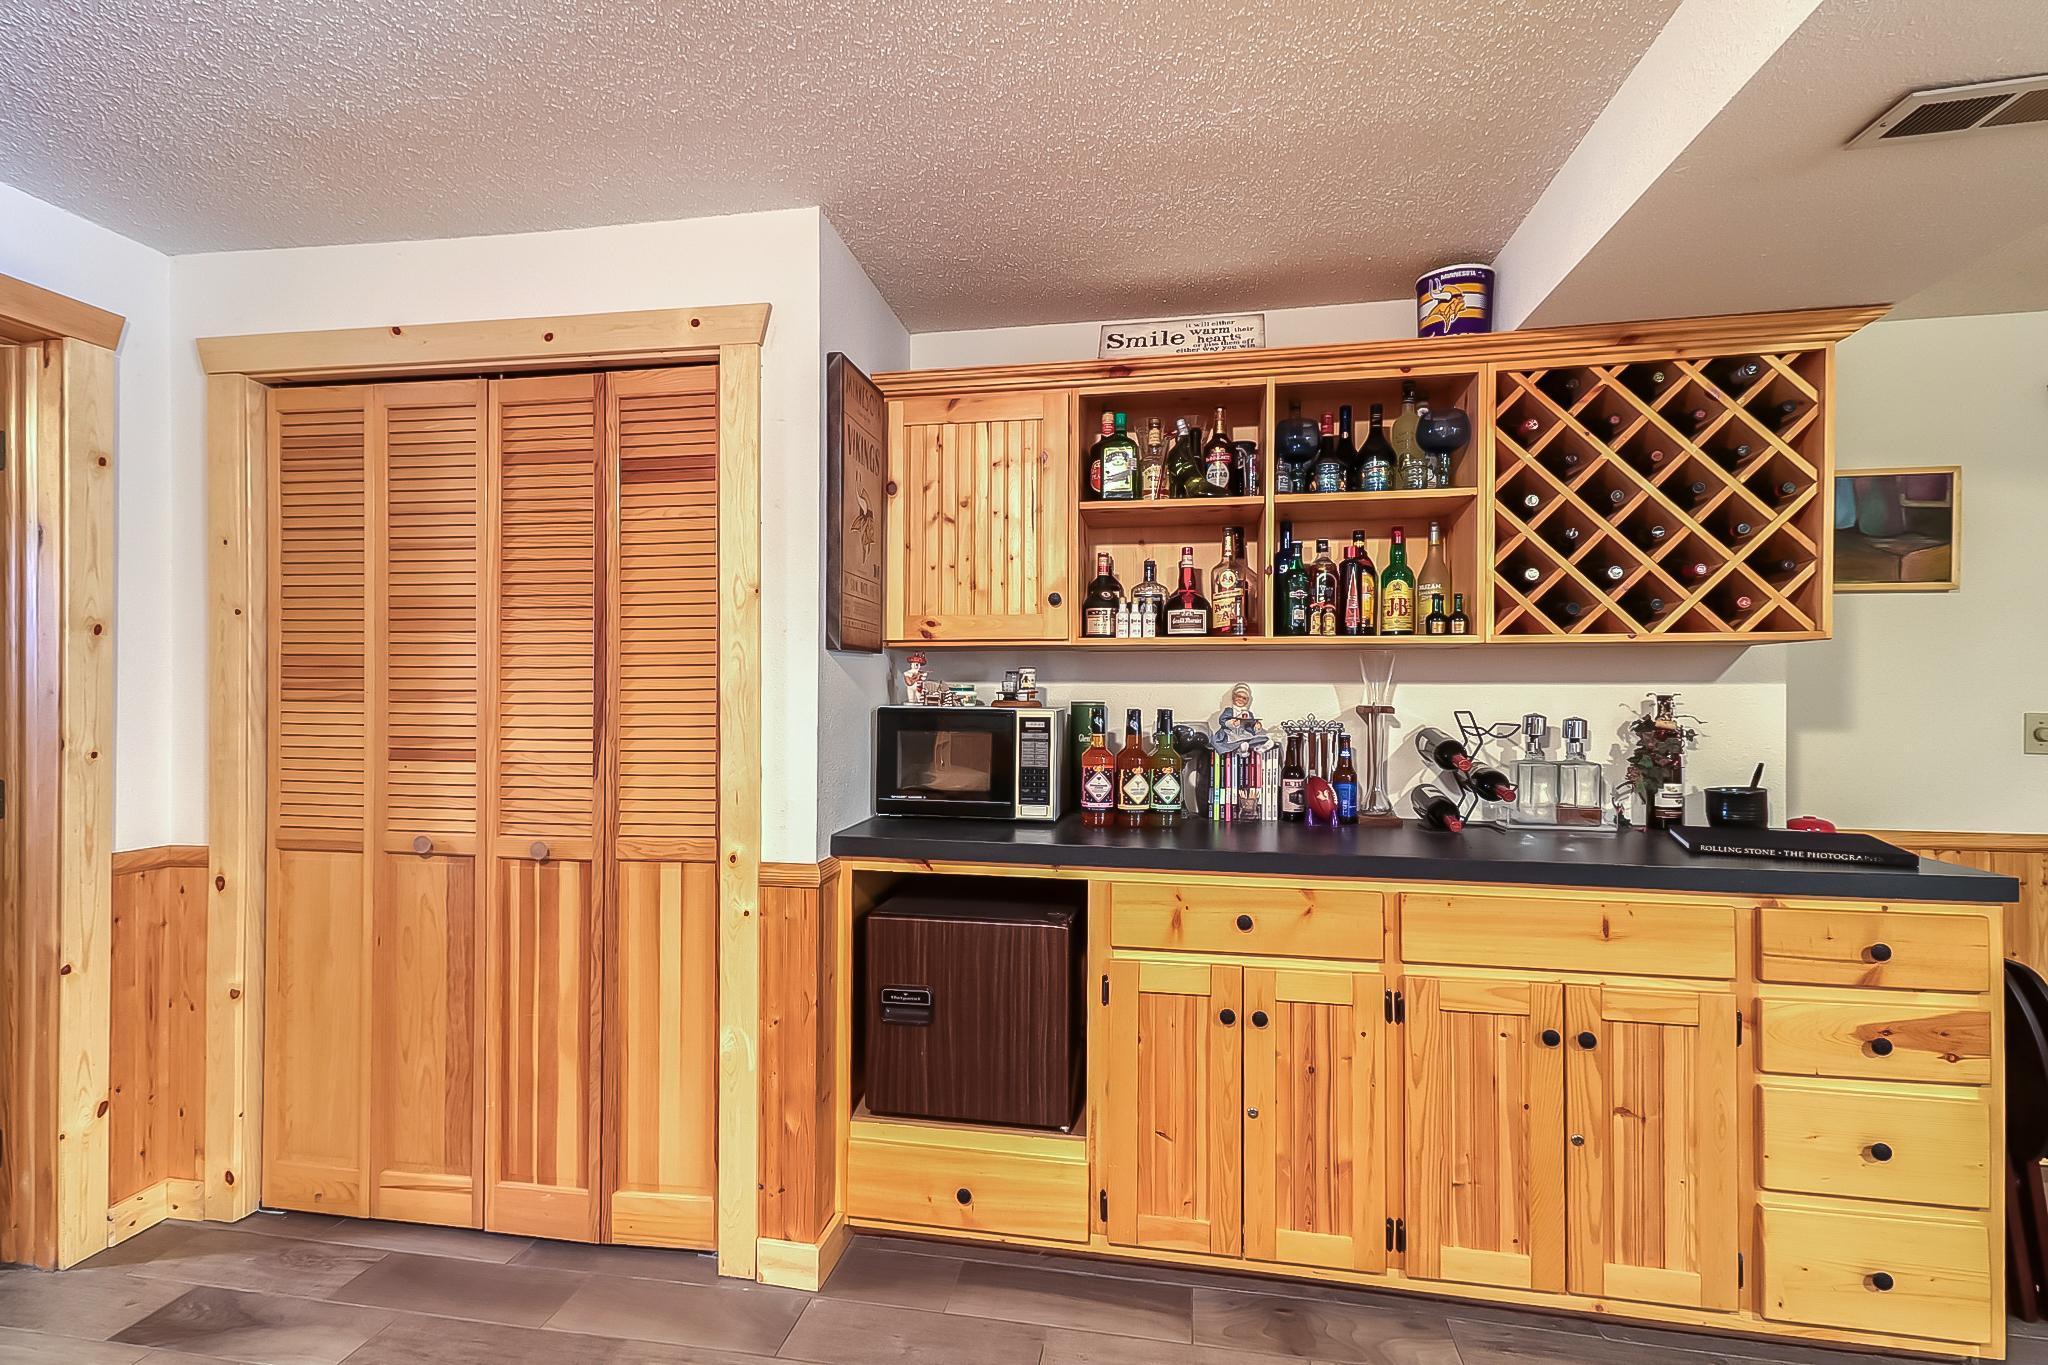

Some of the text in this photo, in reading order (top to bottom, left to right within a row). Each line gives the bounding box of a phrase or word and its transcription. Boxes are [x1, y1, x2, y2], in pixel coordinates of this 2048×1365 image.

[1189, 327, 1230, 335] warm
[1197, 333, 1242, 343] hearts
[1106, 330, 1185, 349] Smile
[847, 423, 881, 477] VIKINGS
[1700, 844, 1742, 854] ROLLING
[1744, 848, 1776, 856] STONE
[1783, 849, 1804, 858] THE
